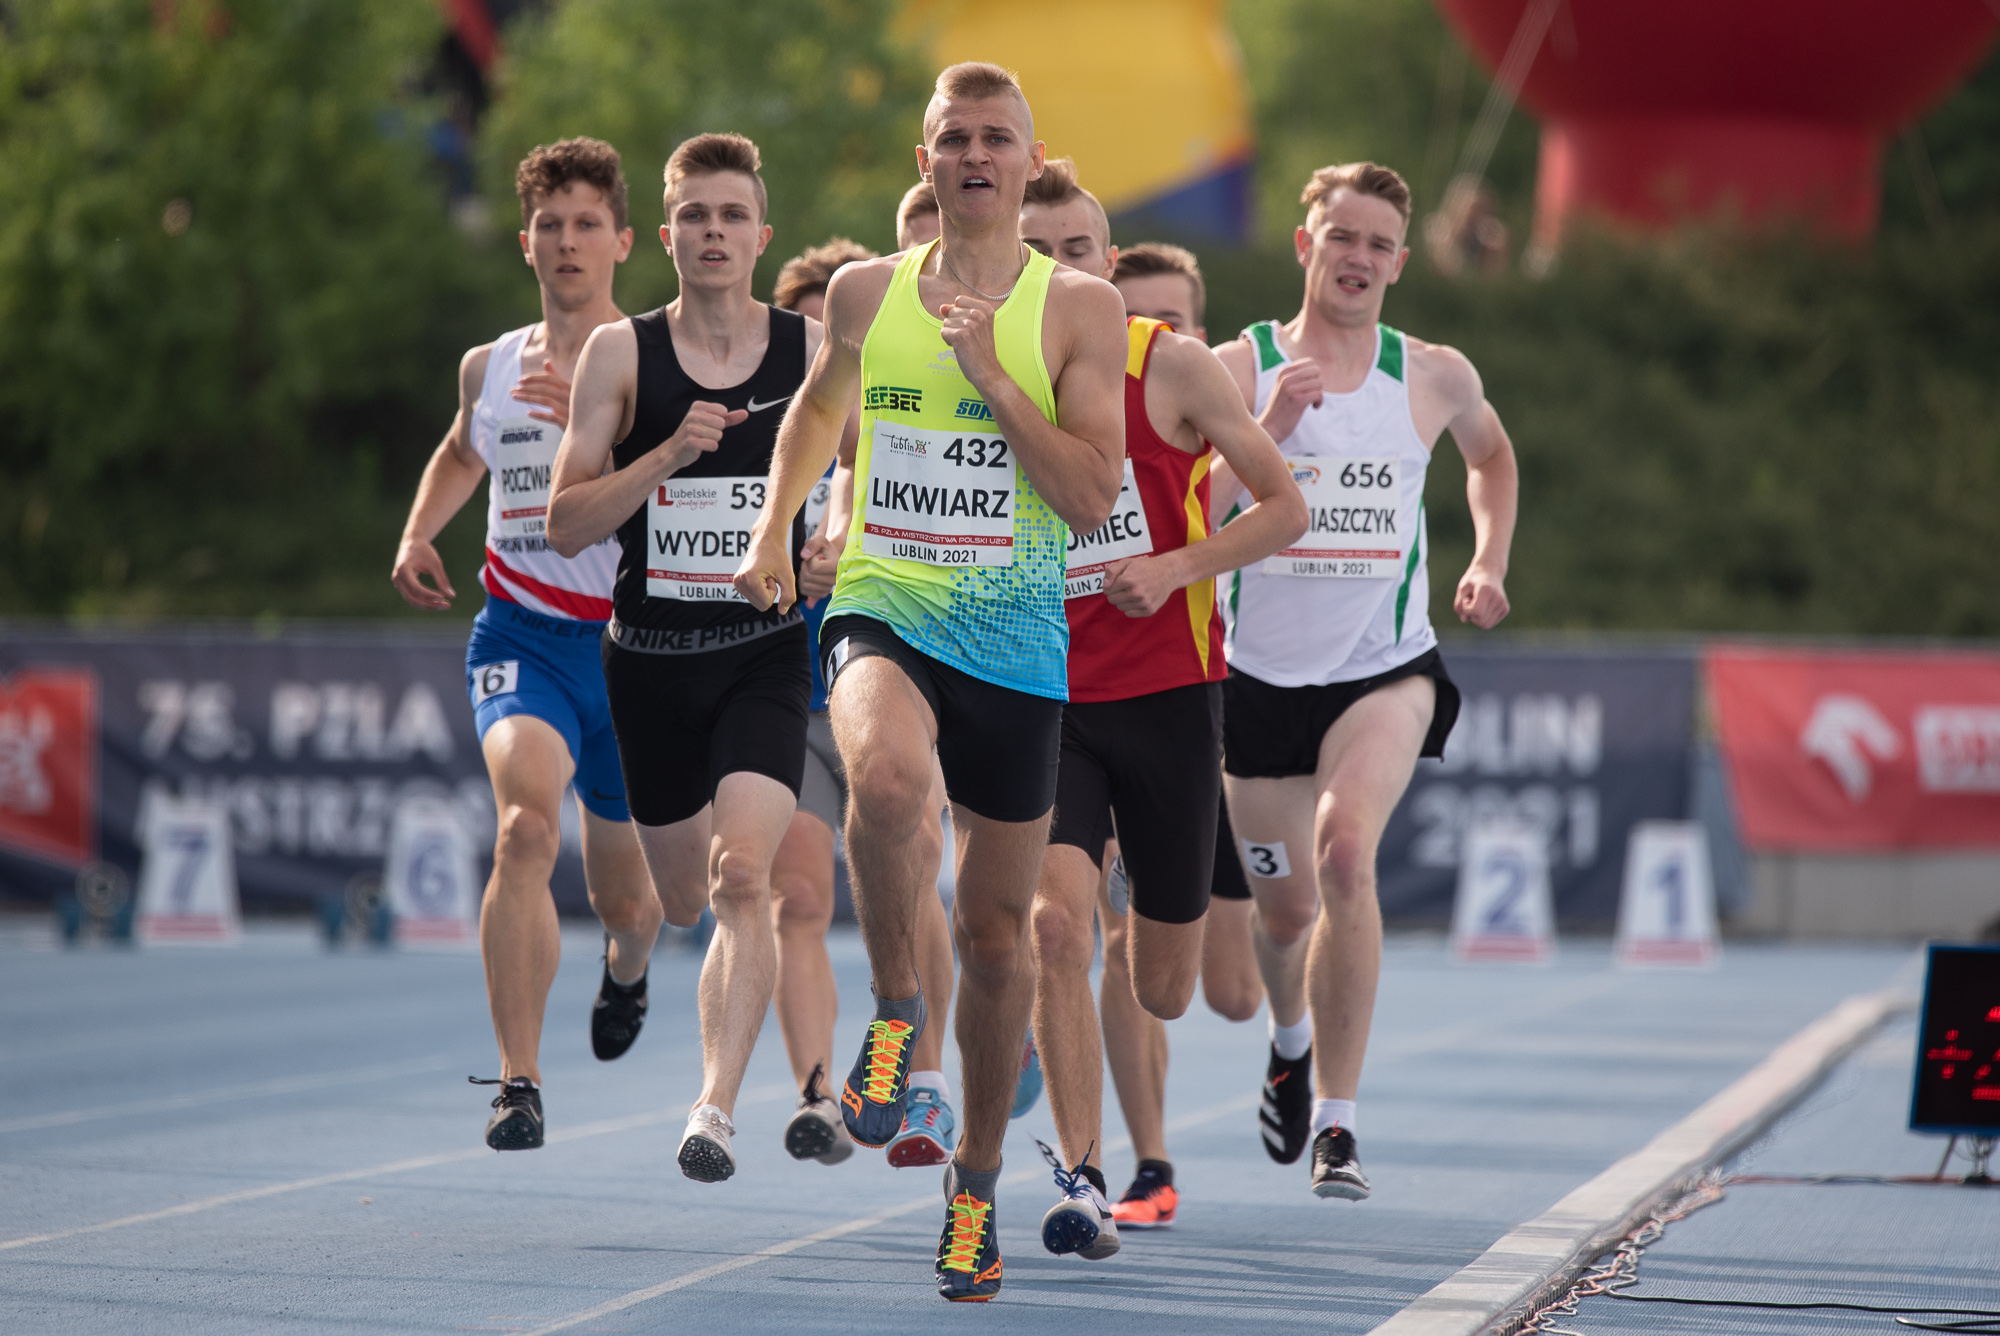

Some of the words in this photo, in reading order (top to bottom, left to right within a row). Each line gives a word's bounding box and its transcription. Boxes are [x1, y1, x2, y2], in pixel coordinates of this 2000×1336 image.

[943, 438, 1008, 468] 432
[1340, 463, 1393, 489] 656
[872, 477, 1010, 518] LIKWIARZ
[881, 527, 900, 537] PZLA
[901, 531, 958, 543] MISTRZOSTWA
[1309, 507, 1396, 534] IASZCZYK
[892, 543, 937, 562] LUBLIN
[942, 550, 976, 563] 2021
[1292, 562, 1338, 575] LUBLIN
[1342, 563, 1372, 575] 2021
[680, 585, 726, 599] LUBLIN
[629, 630, 694, 650] NIKE
[699, 621, 755, 648] PRO
[482, 663, 505, 696] 6
[165, 823, 210, 914] 7
[1249, 846, 1279, 876] 3
[1479, 846, 1529, 935] 2
[1652, 856, 1687, 940] 1
